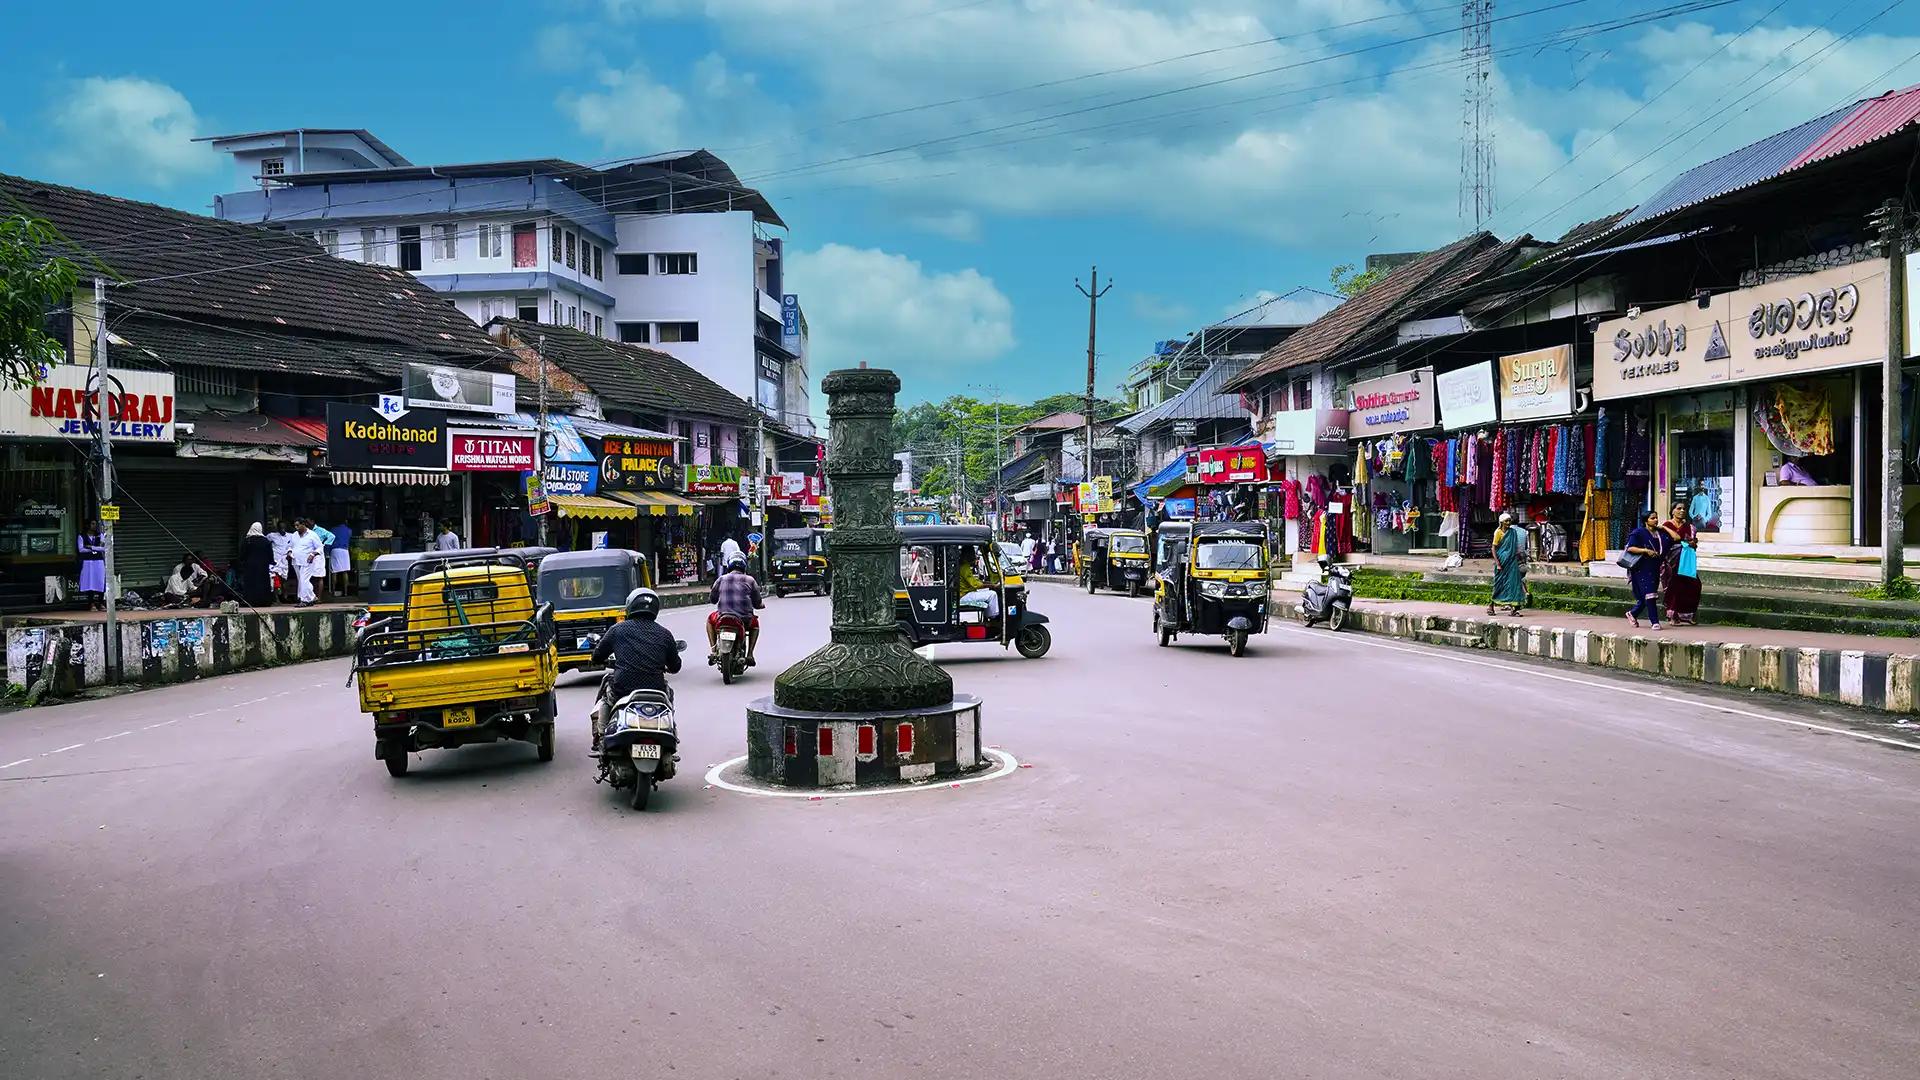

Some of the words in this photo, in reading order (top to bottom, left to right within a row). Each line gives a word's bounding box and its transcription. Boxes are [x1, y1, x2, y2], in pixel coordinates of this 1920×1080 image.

[1613, 320, 1687, 363] Sobha
[1512, 359, 1557, 395] Surya
[1619, 360, 1680, 380] TEXTILES
[59, 419, 165, 438] JEWLLERY
[344, 420, 437, 444] Kadathanad
[1321, 426, 1345, 438] Silky
[477, 440, 522, 454] TITAN
[604, 441, 622, 454] ICE
[623, 441, 631, 455] &
[634, 443, 672, 457] BIRIYANI
[454, 454, 485, 464] KRISHNA
[486, 455, 508, 465] WATCH
[508, 455, 531, 465] WORKS
[621, 458, 657, 472] PALACE
[567, 470, 589, 482] STORE
